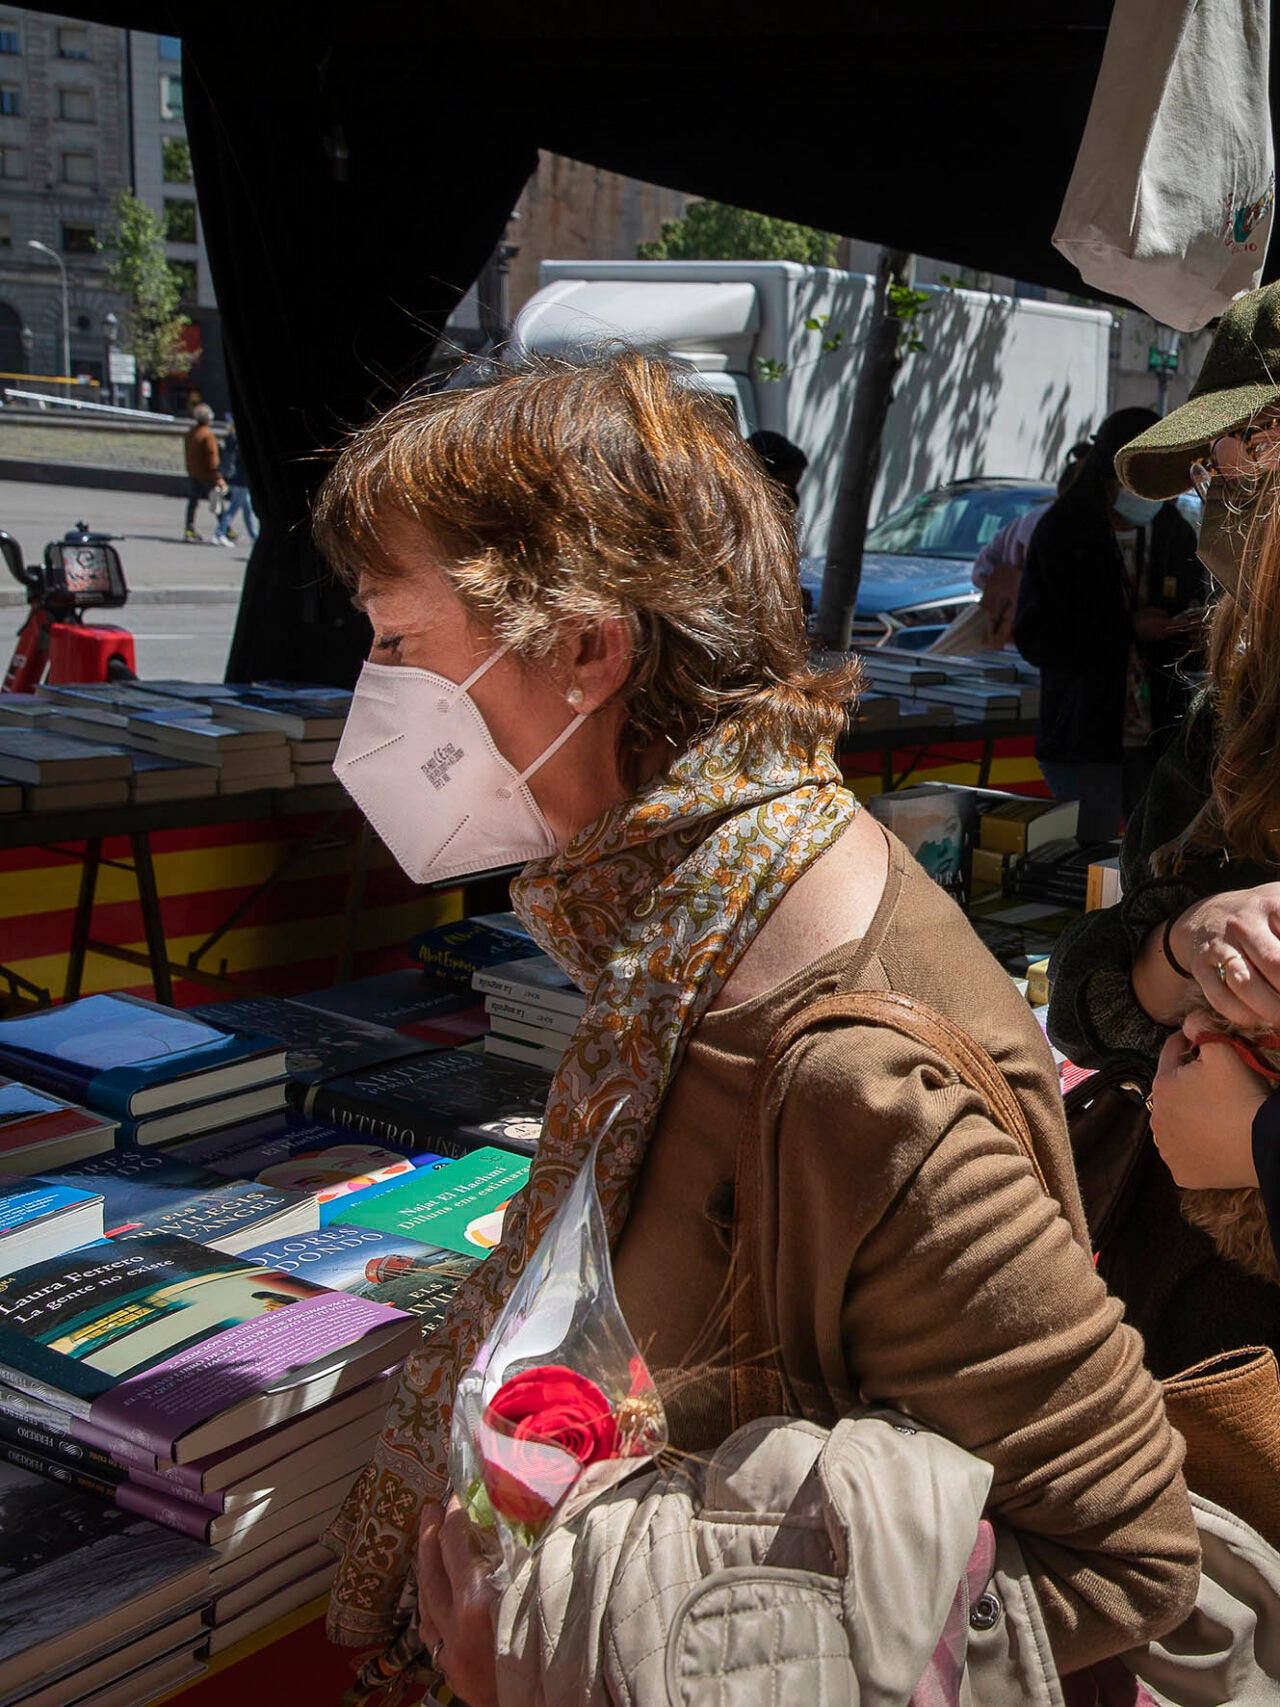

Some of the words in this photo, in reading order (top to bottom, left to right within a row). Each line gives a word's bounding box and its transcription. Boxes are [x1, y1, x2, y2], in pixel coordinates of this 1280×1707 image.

[354, 1054, 475, 1091] ARTURO
[329, 1104, 416, 1149] ARTURO
[399, 1198, 440, 1217] Najat
[438, 1191, 456, 1202] El
[456, 1166, 508, 1193] Hachmi
[161, 1207, 196, 1222] ELS
[398, 1205, 453, 1231] Dilluns
[454, 1196, 477, 1208] ens
[275, 1233, 384, 1272] DONDO
[0, 1280, 67, 1316] Laura
[63, 1255, 145, 1284] Ferrero
[13, 1310, 44, 1325] La
[46, 1284, 96, 1311] gente
[98, 1275, 123, 1287] no
[126, 1260, 175, 1277] existe
[408, 1283, 443, 1299] ELS
[173, 1358, 204, 1378] LIBRO
[204, 1349, 220, 1362] DE
[220, 1343, 233, 1353] LA
[234, 1323, 271, 1349] AUTORA
[273, 1319, 287, 1328] DE
[287, 1303, 325, 1325] PISCINAS
[174, 1369, 194, 1384] VAS
[201, 1348, 236, 1371] HACER
[236, 1337, 258, 1353] CON
[258, 1331, 271, 1341] EL
[272, 1318, 301, 1334] RESTO
[329, 1300, 352, 1314] VIDA
[178, 1337, 222, 1363] EDICIÓN
[222, 1330, 237, 1342] EN
[237, 1319, 258, 1335] UNA
[259, 1305, 296, 1326] SEMANA
[17, 1426, 54, 1447] FERRERO
[8, 1449, 44, 1472] FERRERO
